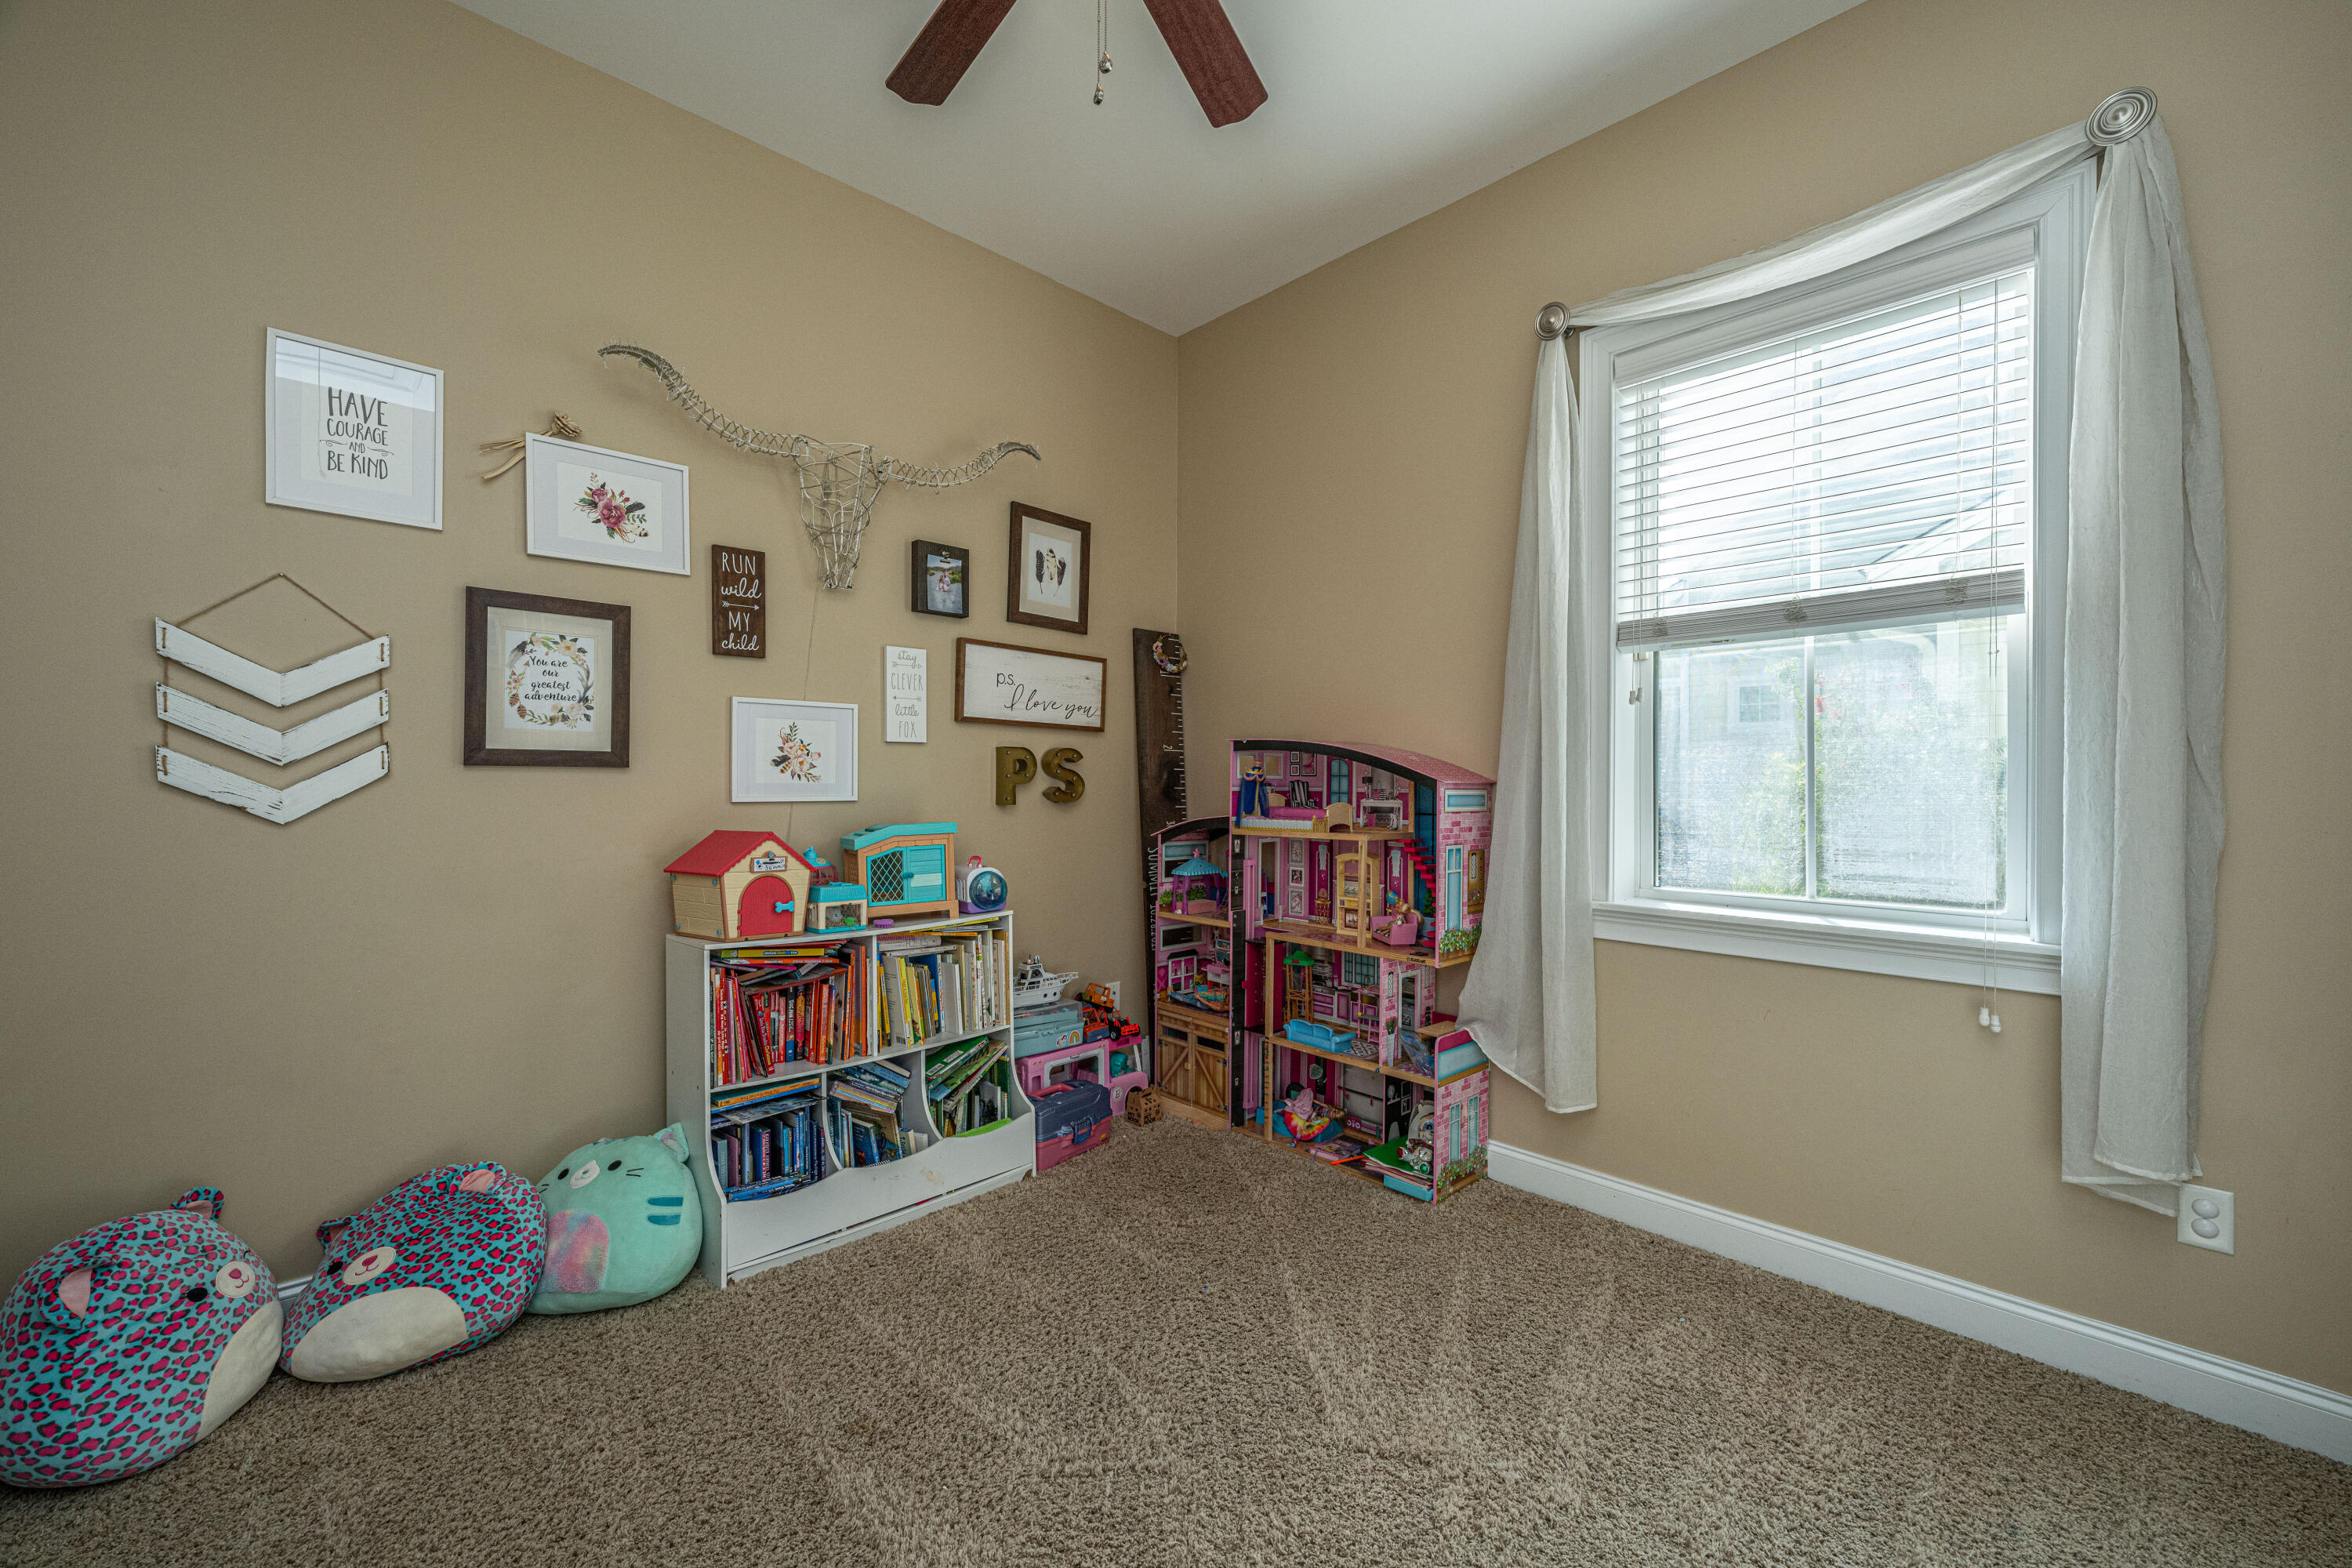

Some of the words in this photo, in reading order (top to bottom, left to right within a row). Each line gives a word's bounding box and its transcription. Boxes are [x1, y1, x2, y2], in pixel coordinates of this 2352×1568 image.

[328, 387, 388, 426] HAVE
[327, 418, 388, 446] COURAGE
[349, 441, 365, 453] AND
[328, 450, 345, 472] BE
[351, 453, 388, 479] KIND
[722, 552, 756, 575] RUN
[721, 577, 761, 598] wild
[728, 611, 750, 632] MY
[721, 633, 760, 651] child
[529, 655, 549, 666] You
[898, 651, 917, 669] stay
[543, 669, 559, 677] our
[891, 673, 924, 691] CLEVER
[531, 681, 571, 691] greatest
[524, 690, 578, 702] adventure
[1004, 684, 1025, 712] I
[1025, 689, 1062, 711] love
[1065, 704, 1098, 720] you
[895, 703, 920, 717] little
[898, 720, 916, 738] FOX
